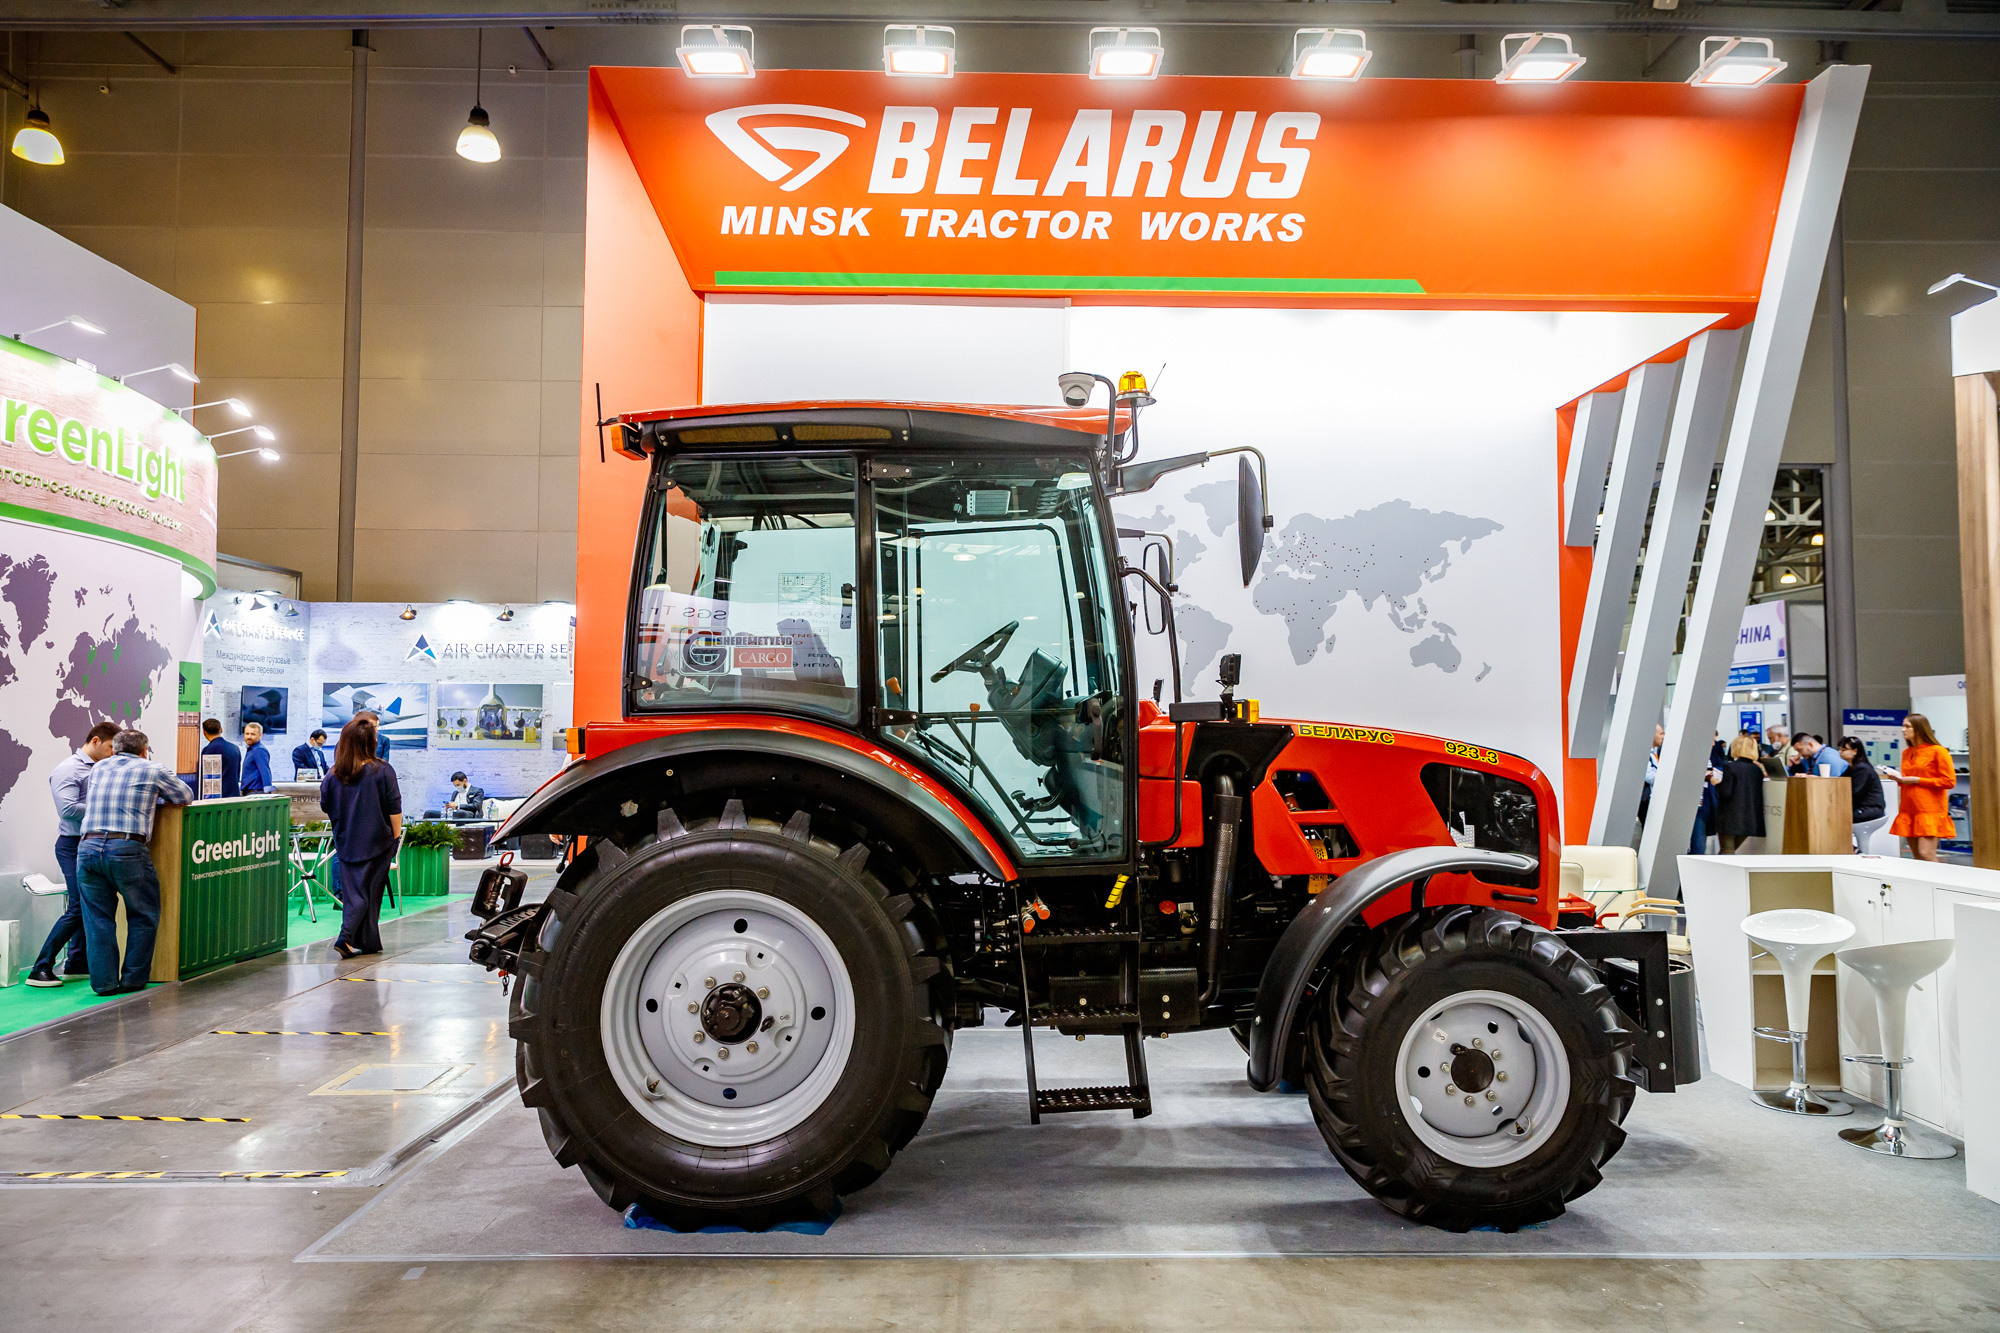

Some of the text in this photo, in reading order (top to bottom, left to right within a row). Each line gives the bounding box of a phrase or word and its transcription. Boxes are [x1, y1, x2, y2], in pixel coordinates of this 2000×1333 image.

[868, 106, 1321, 199] BELARUS
[720, 206, 1306, 242] MINSK TRACTOR WORKS
[2, 398, 186, 504] reenLight
[1736, 625, 1771, 645] HINA
[444, 643, 568, 654] AIR CHARTER SE
[738, 652, 787, 664] CARGO
[1298, 724, 1395, 744] БЕЛАРУС
[1445, 741, 1499, 765] 923.3
[192, 830, 281, 864] GreenLight
